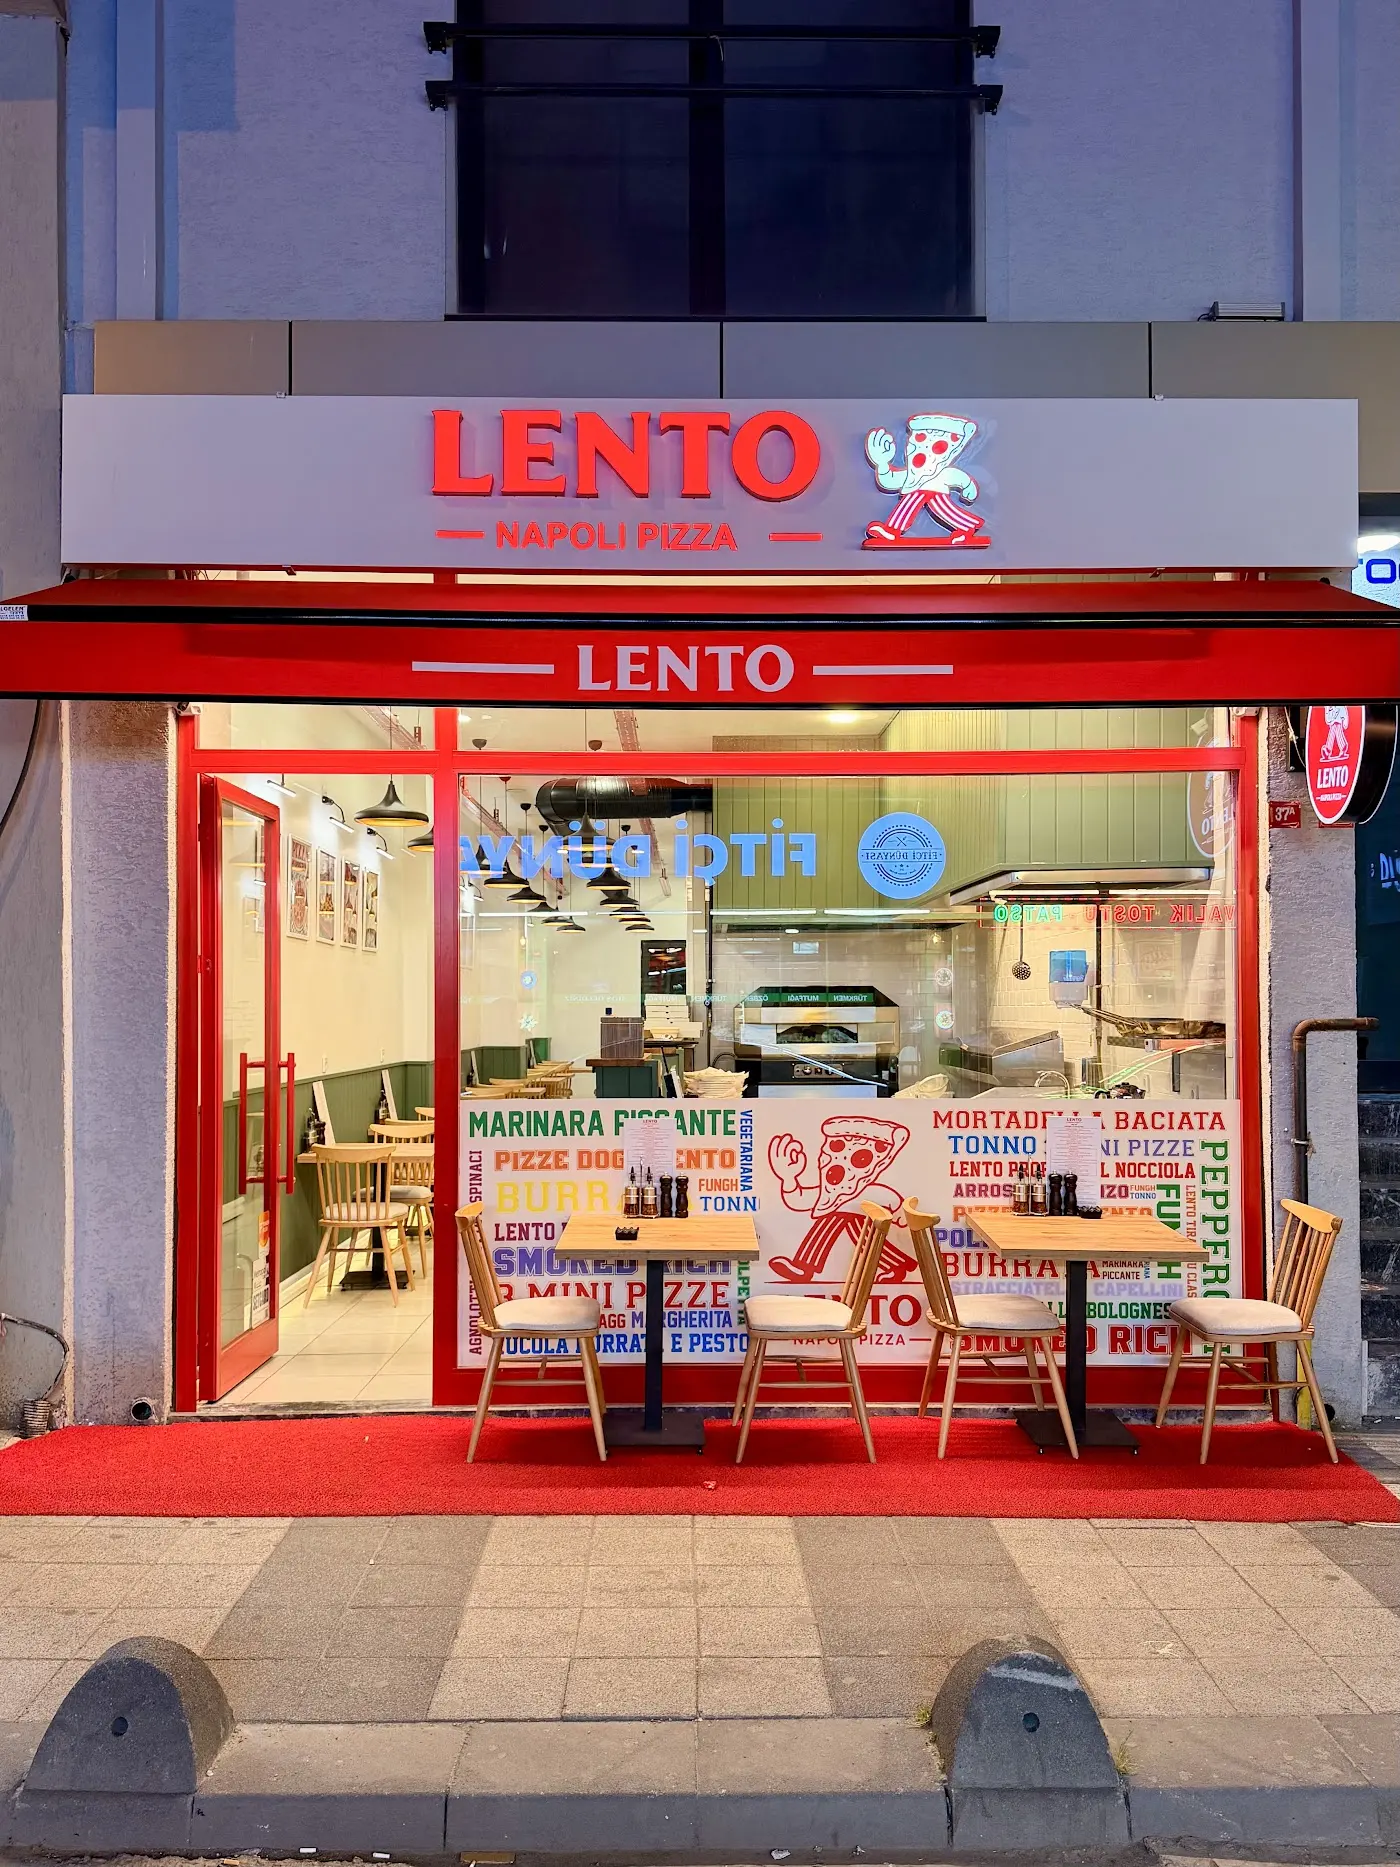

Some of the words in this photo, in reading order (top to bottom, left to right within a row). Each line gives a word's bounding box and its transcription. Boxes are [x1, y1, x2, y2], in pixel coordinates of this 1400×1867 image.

[432, 410, 821, 501] LENTO
[496, 521, 626, 550] NAPOLI
[637, 522, 738, 551] PIZZA
[577, 644, 795, 692] LENTO
[1316, 765, 1349, 789] LENTO
[468, 1109, 605, 1138] MARINARA
[1115, 1111, 1226, 1131] BACIATA
[740, 1109, 753, 1193] VEGETARIANA
[948, 1135, 1037, 1155] TONNO
[1128, 1139, 1195, 1157] PIZZE
[494, 1148, 570, 1171] PIZZE
[949, 1160, 1003, 1178] LENTO
[1115, 1161, 1196, 1179] NOCCIOLA
[469, 1150, 483, 1203] SPINACI
[698, 1178, 739, 1192] FUNGH
[1129, 1184, 1156, 1192] FUNGH
[1129, 1192, 1157, 1200] TONNO
[700, 1196, 760, 1212] TONN
[1185, 1184, 1197, 1218] LENTO
[494, 1222, 555, 1242] LENTO
[625, 1280, 732, 1309] PZZE
[1093, 1281, 1184, 1297] CAPELLINI
[1086, 1301, 1172, 1320] BOLOGNES
[501, 1335, 569, 1355] UCOLA
[671, 1333, 684, 1353] E
[688, 1333, 750, 1353] PESTO
[859, 1333, 906, 1346] PIZZA
